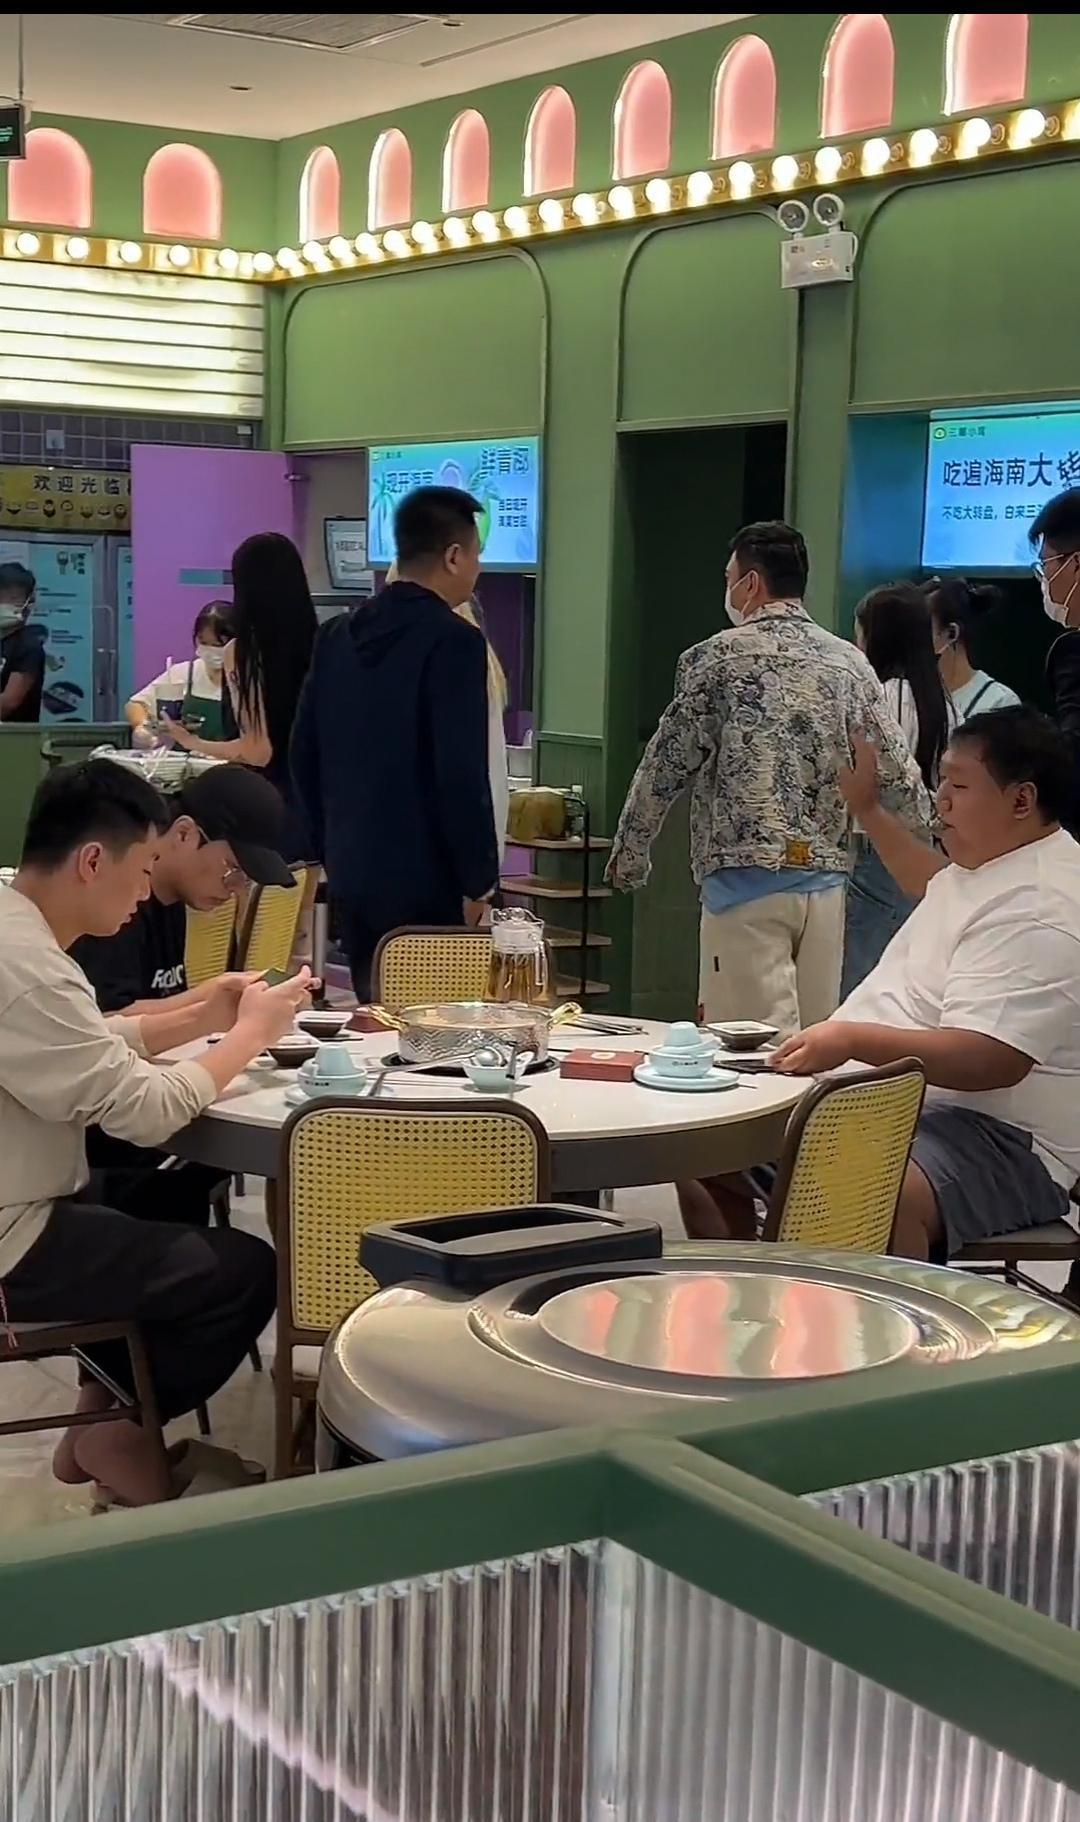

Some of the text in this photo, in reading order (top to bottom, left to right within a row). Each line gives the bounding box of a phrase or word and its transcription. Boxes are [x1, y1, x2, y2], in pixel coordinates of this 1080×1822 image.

[33, 475, 131, 496] 欢迎光临
[942, 505, 1043, 520] 不吃大转盘，白来三
